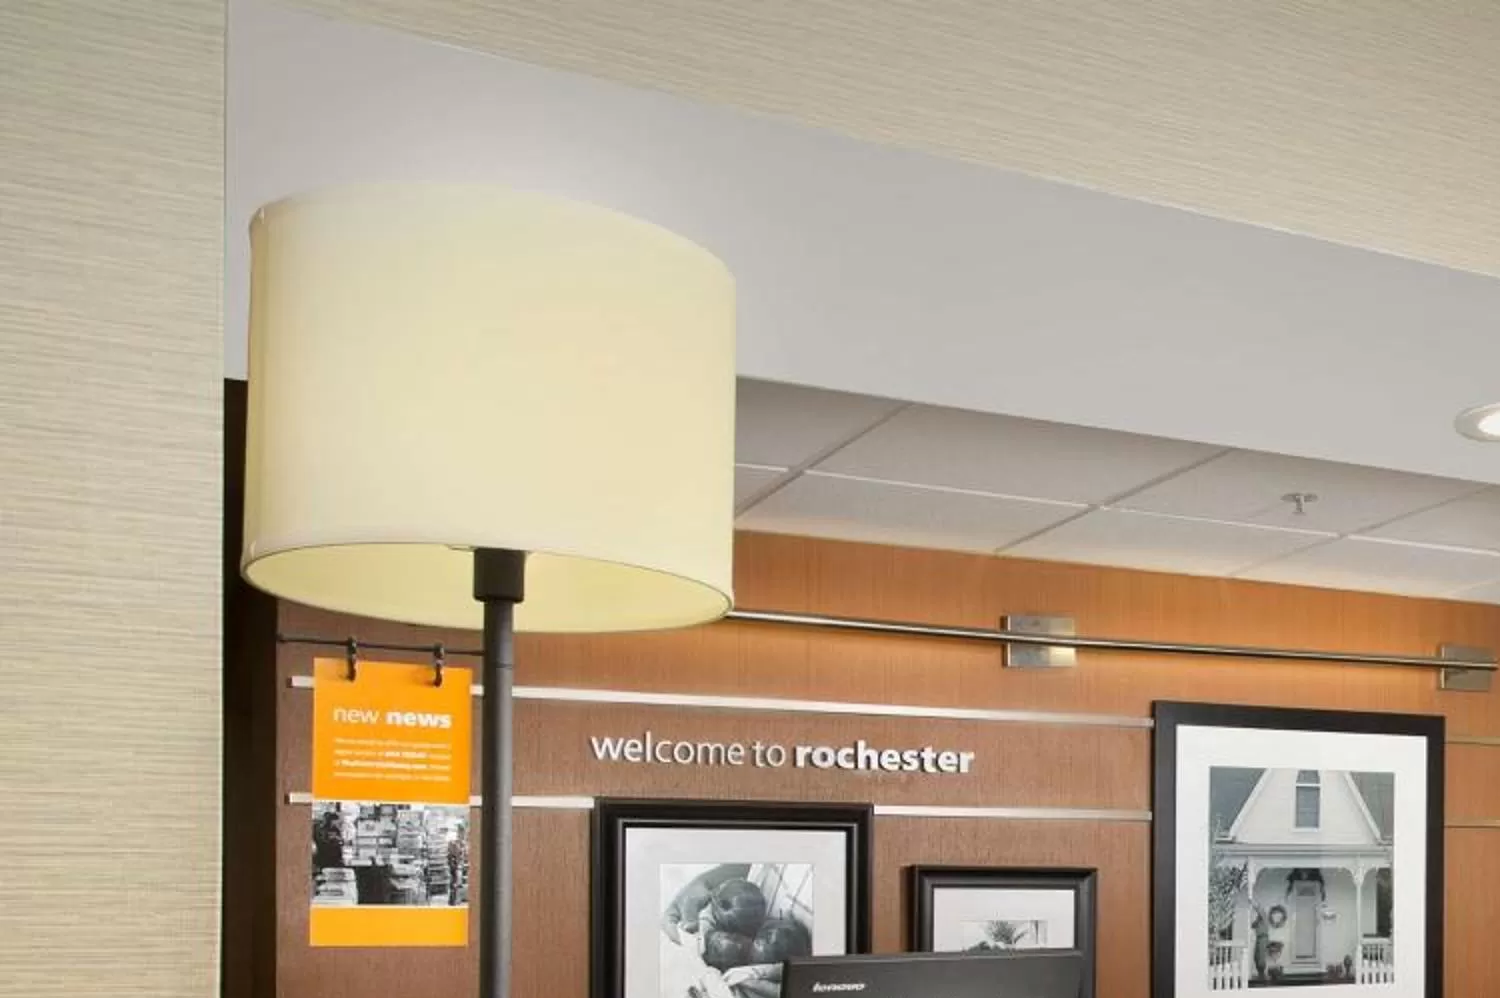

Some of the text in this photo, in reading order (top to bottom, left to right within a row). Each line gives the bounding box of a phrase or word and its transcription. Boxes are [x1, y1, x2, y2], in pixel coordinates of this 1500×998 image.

[333, 706, 451, 729] new news
[591, 731, 974, 774] welcome to rochester
[812, 981, 867, 992] lenovo
